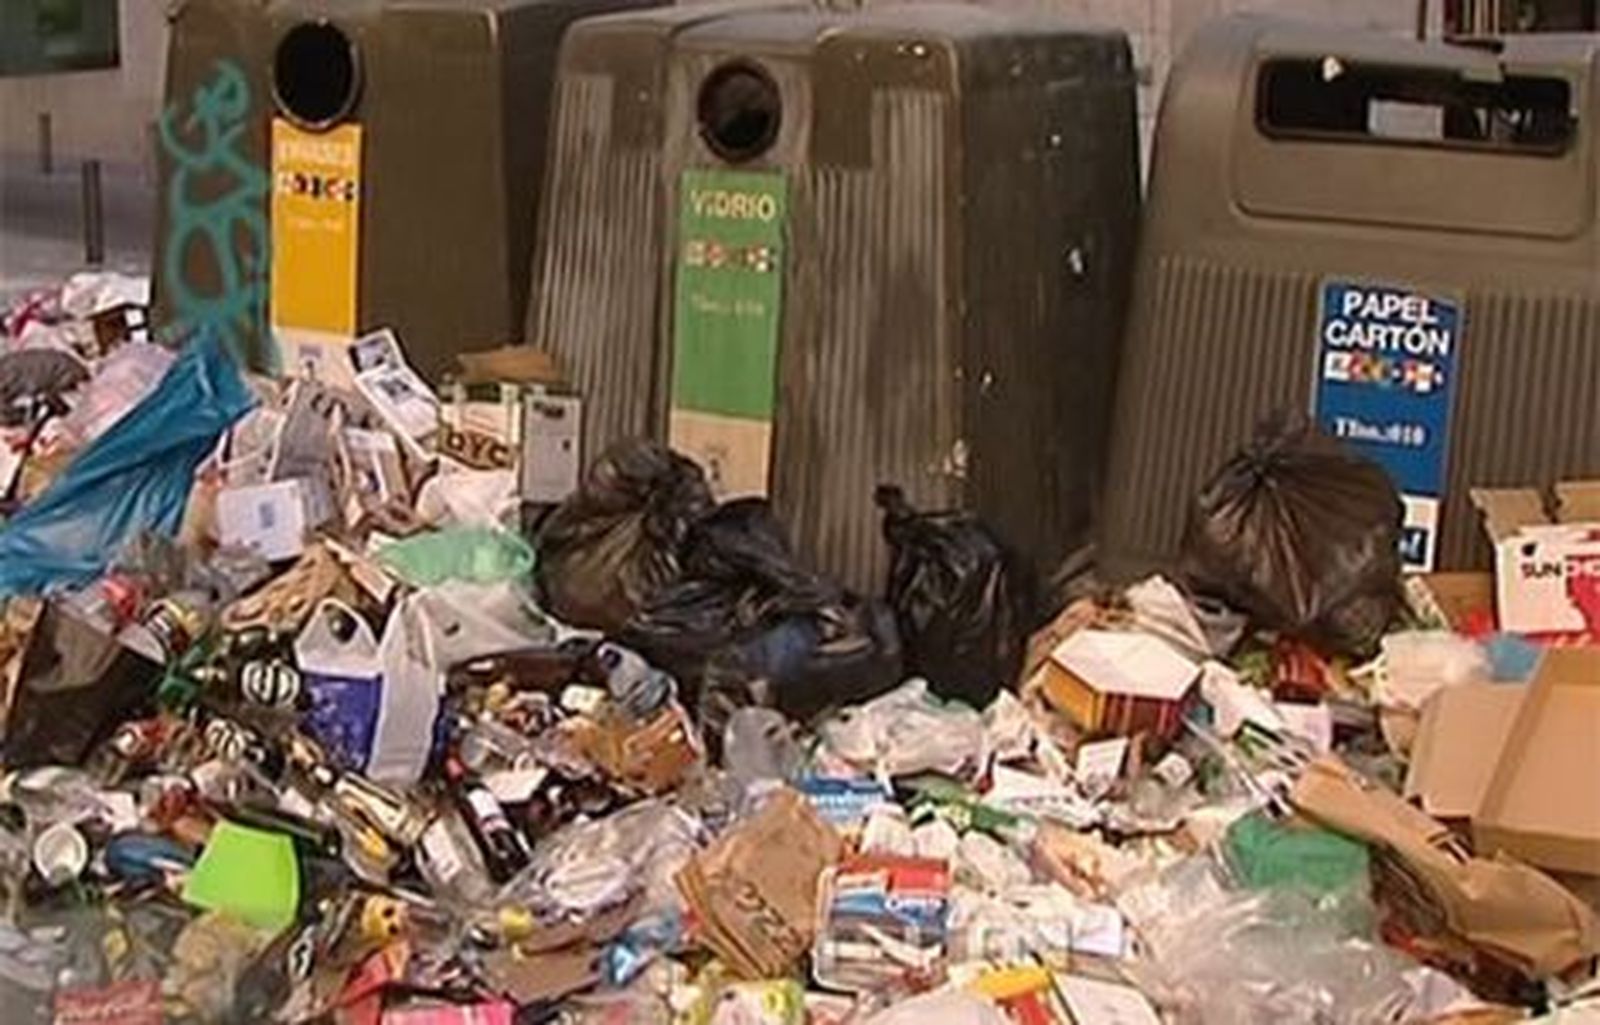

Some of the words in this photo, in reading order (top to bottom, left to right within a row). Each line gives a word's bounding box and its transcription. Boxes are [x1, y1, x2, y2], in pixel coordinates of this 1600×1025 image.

[690, 189, 776, 221] VIDRIO
[1343, 291, 1438, 324] PAPEL
[1325, 319, 1450, 356] CARTÓN
